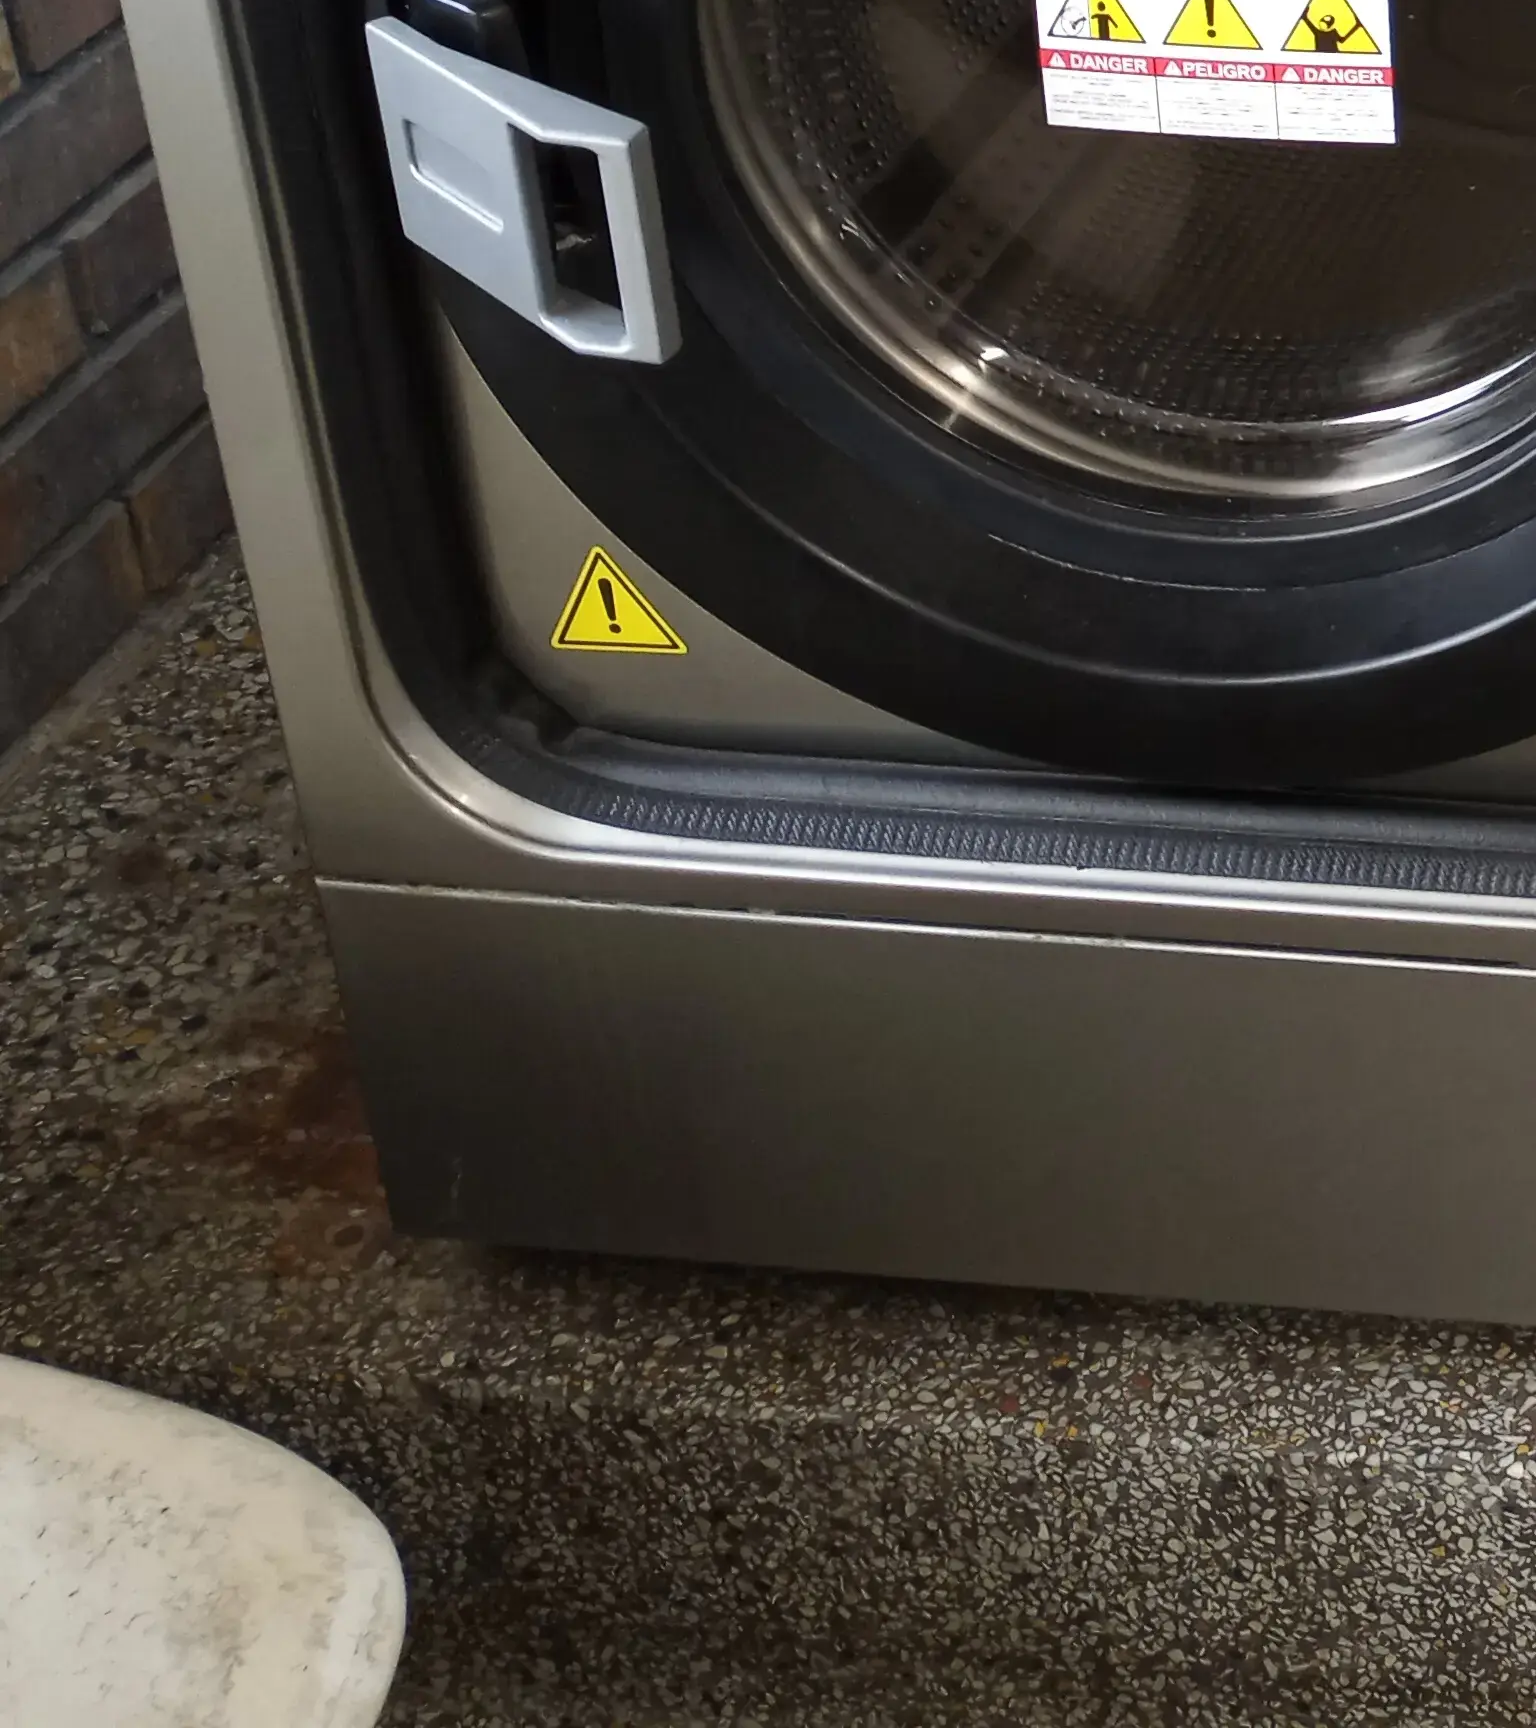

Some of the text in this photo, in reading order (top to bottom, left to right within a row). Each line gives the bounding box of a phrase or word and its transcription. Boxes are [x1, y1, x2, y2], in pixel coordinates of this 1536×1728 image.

[1069, 53, 1149, 74] DANGER
[1182, 61, 1267, 81] PELIGRO
[1303, 67, 1385, 84] DANGER
